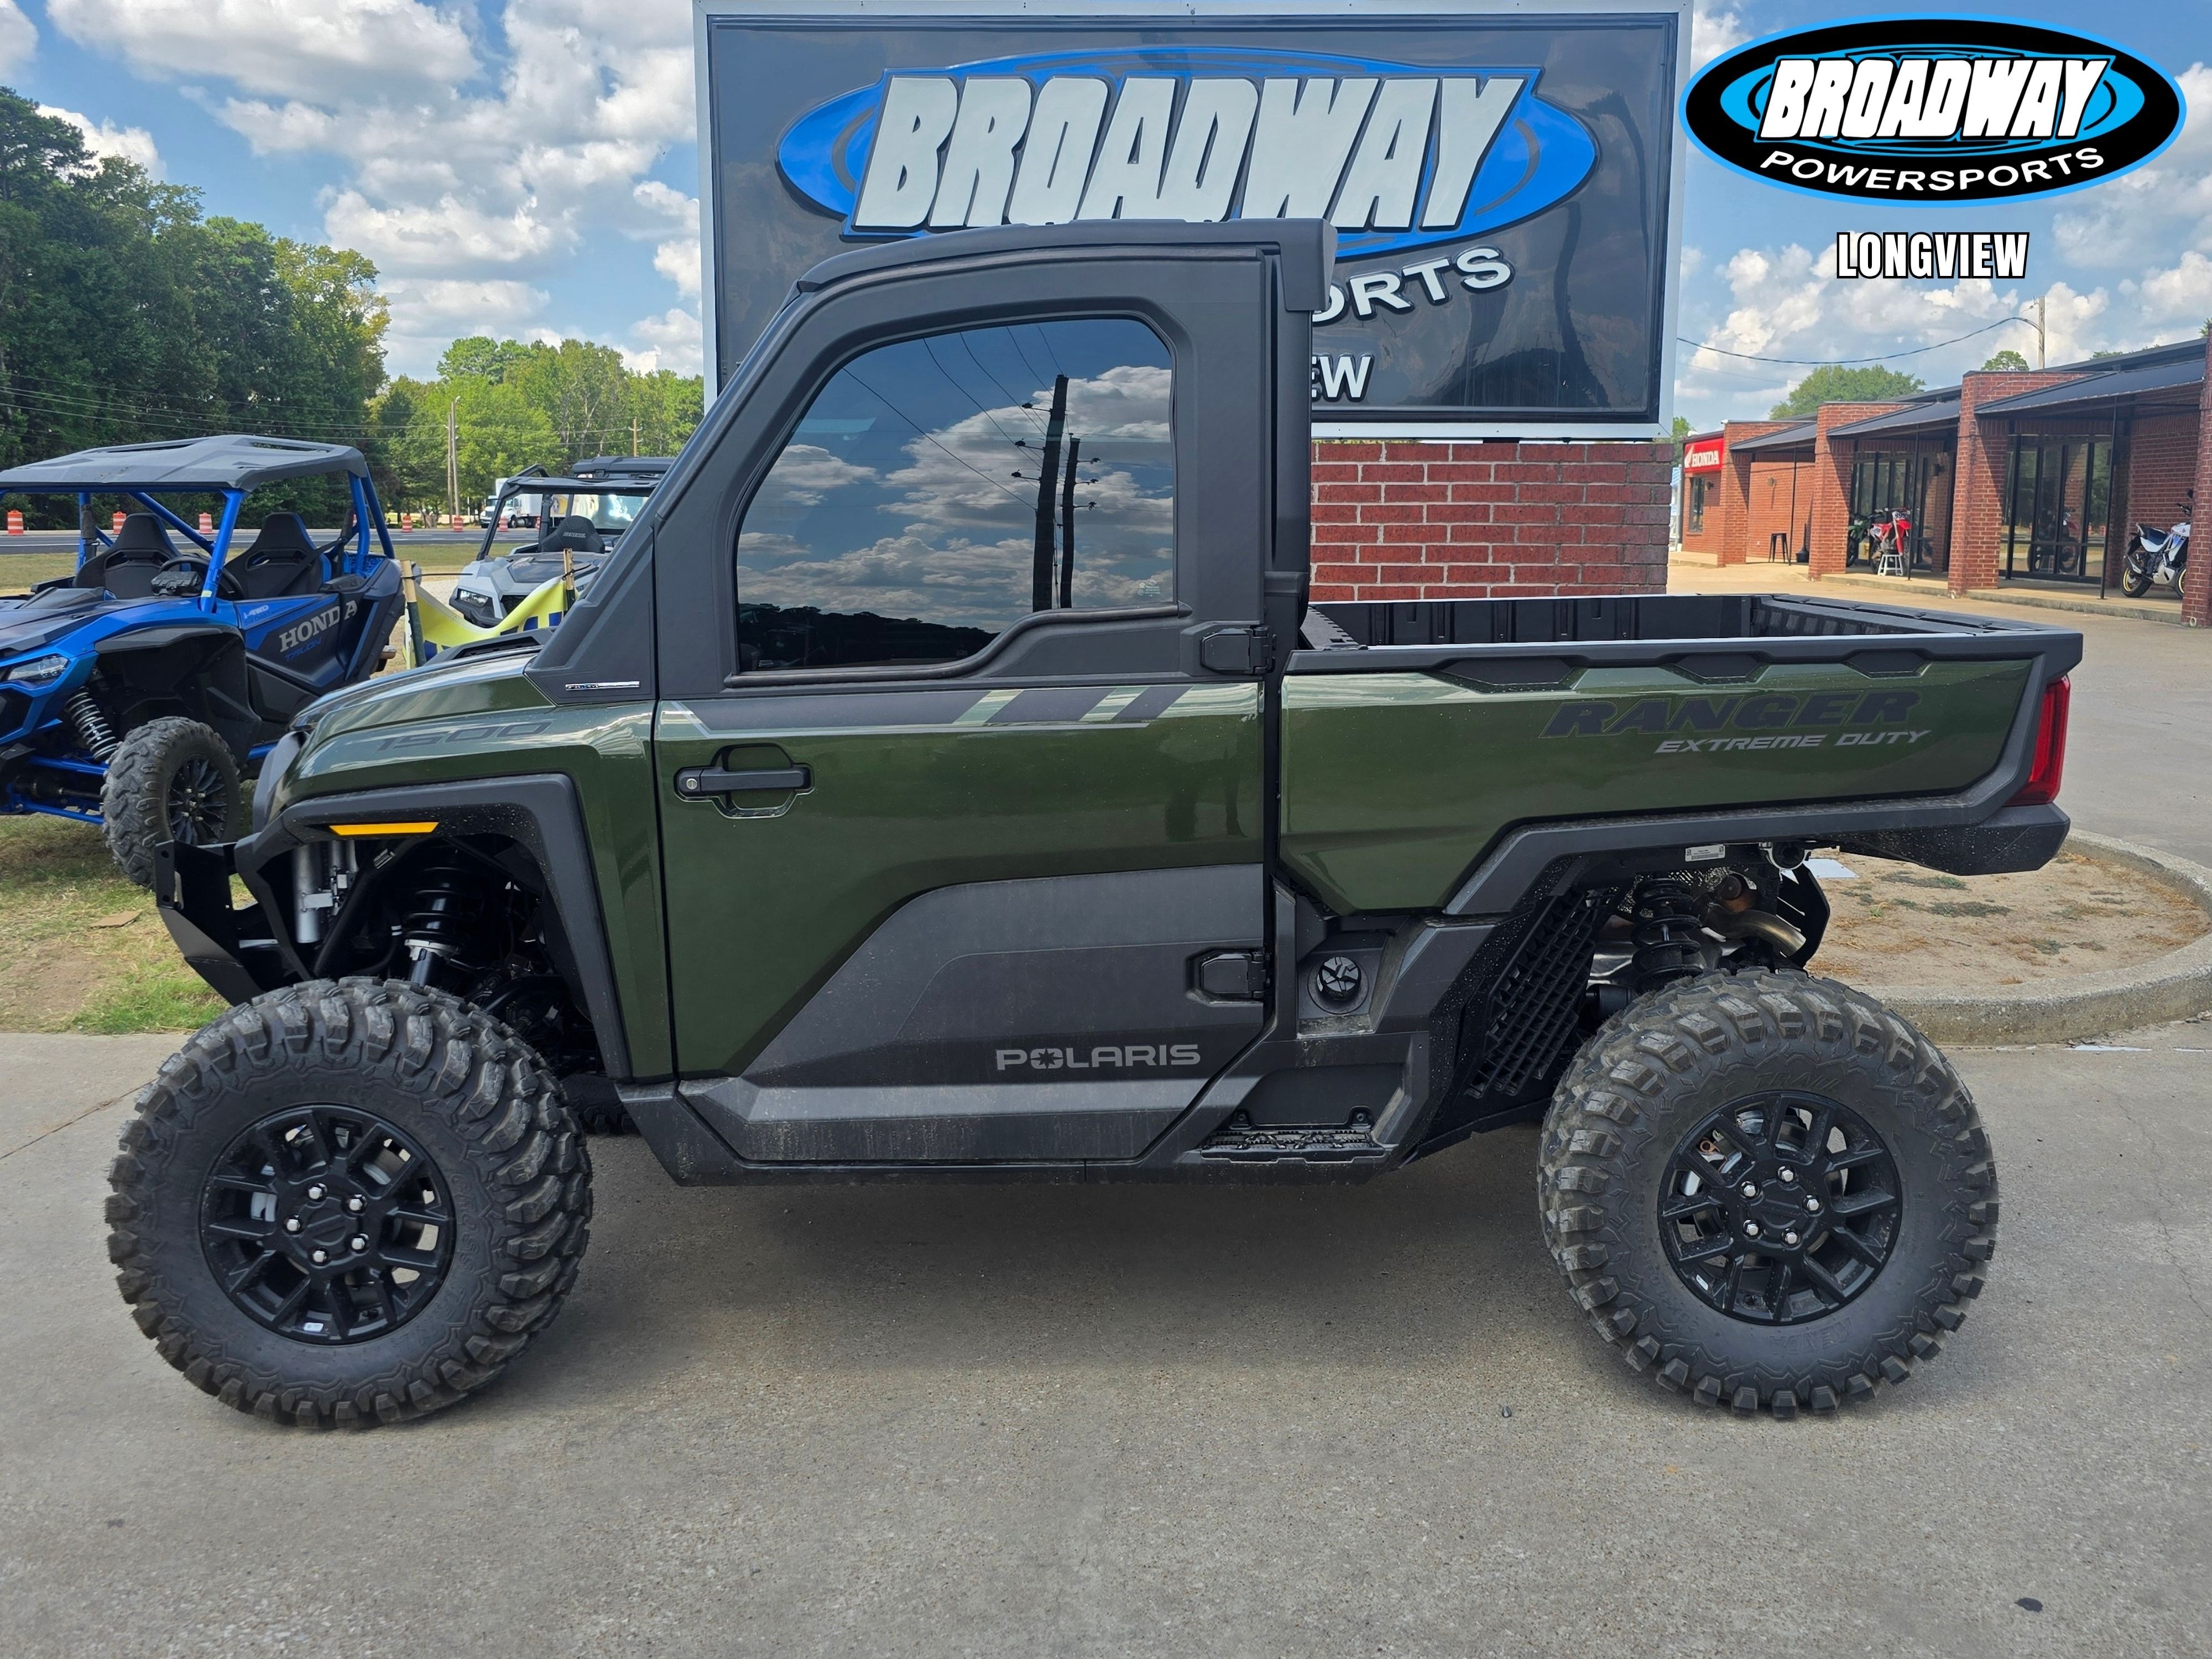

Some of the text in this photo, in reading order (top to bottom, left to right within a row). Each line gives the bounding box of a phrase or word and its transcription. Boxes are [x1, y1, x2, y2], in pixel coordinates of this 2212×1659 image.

[855, 77, 1525, 228] BROADWAY
[1691, 450, 1720, 468] HONDA
[279, 600, 358, 653] HONDA
[284, 637, 322, 661] TALON
[1538, 691, 1923, 739] RANGER
[377, 721, 552, 752] 1500
[1655, 730, 1931, 754] EXTREME DUTY
[996, 1044, 1201, 1071] POLARIS
